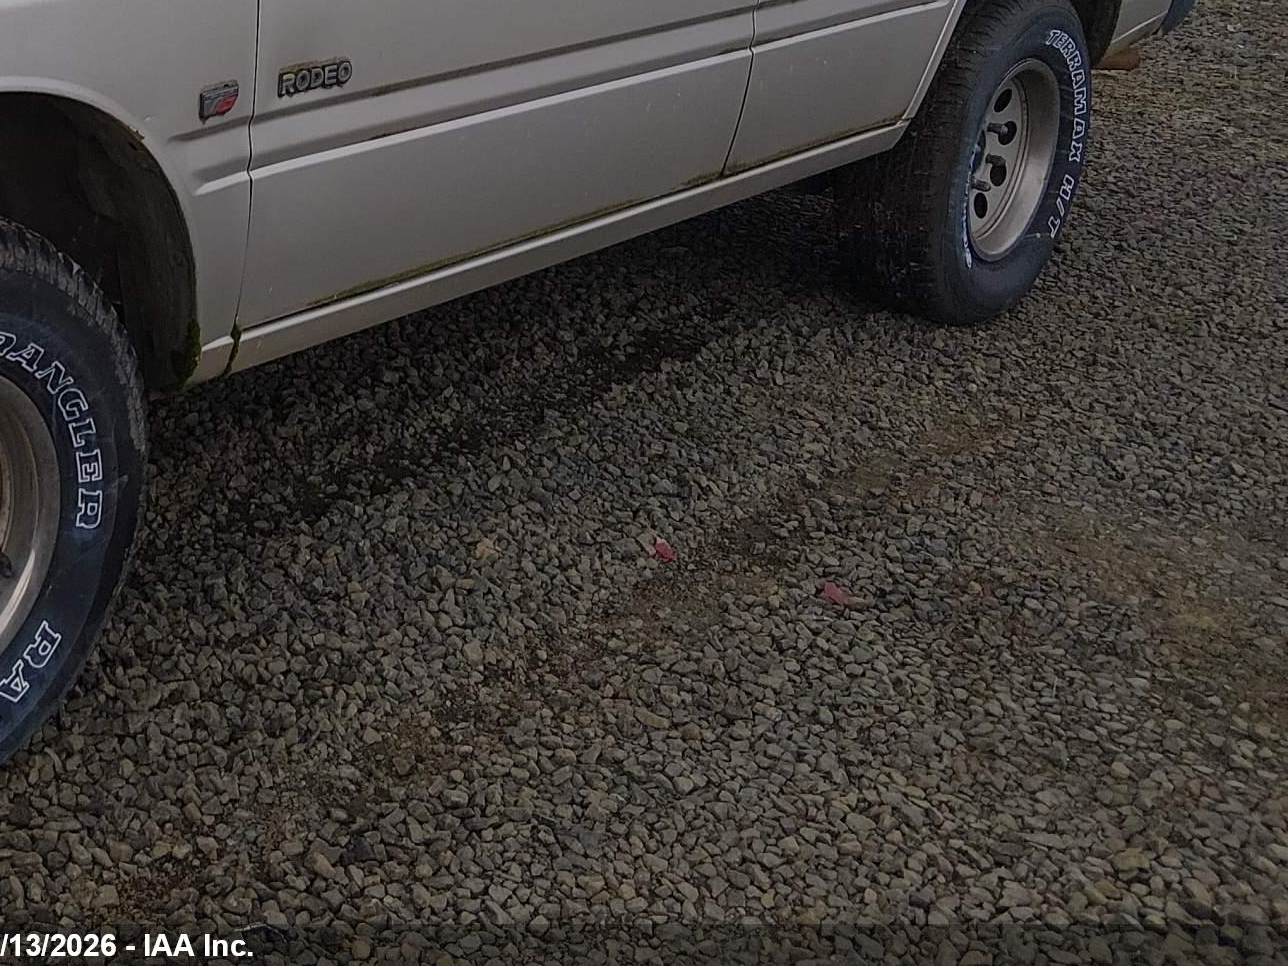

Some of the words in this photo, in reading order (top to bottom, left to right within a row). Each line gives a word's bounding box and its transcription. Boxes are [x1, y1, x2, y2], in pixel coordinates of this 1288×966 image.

[279, 60, 352, 97] RODEO
[1046, 29, 1088, 162] TERRAMAX
[1048, 174, 1076, 238] H/T
